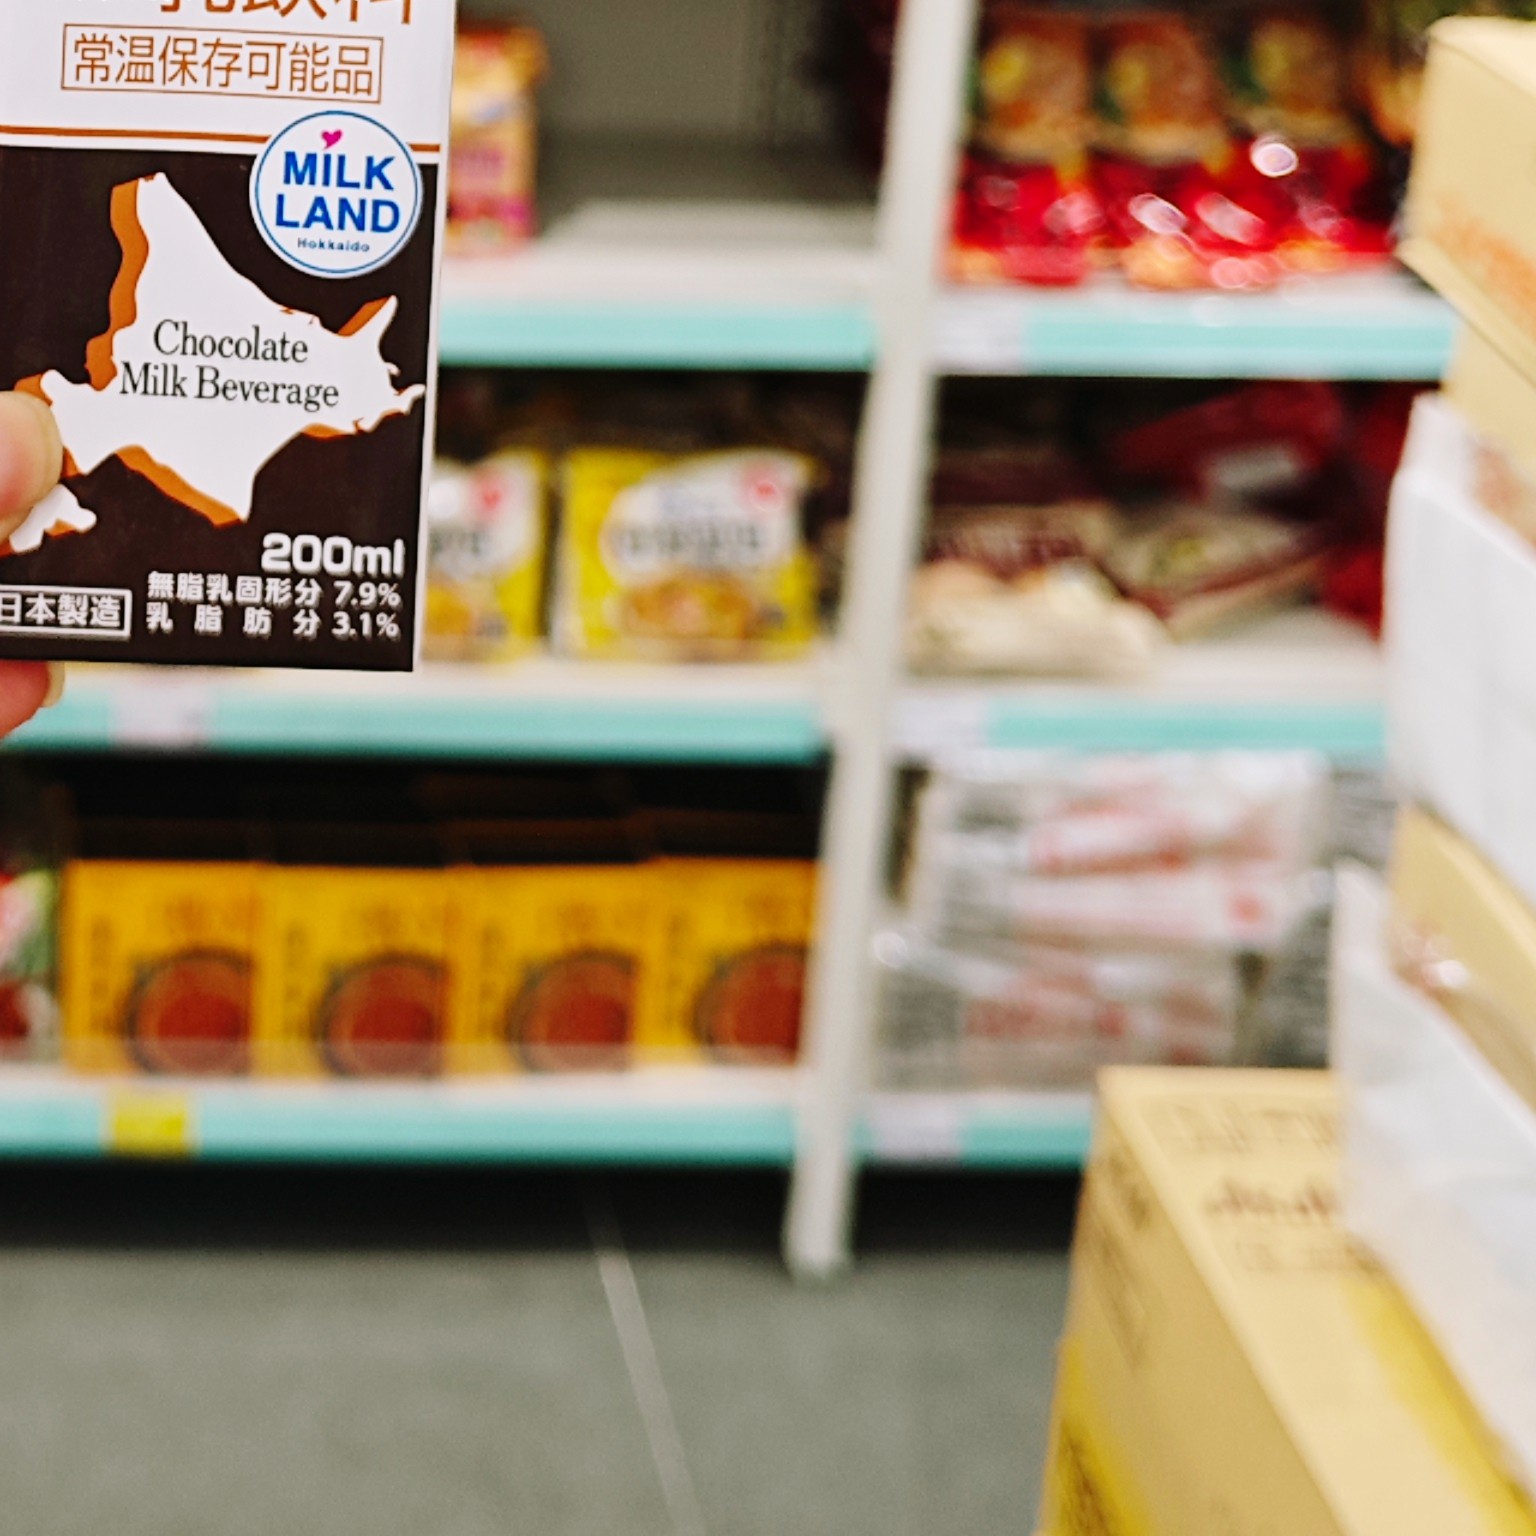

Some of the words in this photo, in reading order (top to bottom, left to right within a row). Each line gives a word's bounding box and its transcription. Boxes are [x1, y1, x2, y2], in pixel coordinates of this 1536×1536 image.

[73, 32, 373, 97] 常温保存可能品
[282, 151, 395, 191] MILK
[275, 193, 401, 233] LAND
[296, 237, 370, 253] Hokkaido
[153, 319, 309, 363] Chocolate
[119, 362, 189, 399] Milk
[194, 365, 341, 412] Beverage
[261, 532, 405, 576] 200ml
[147, 571, 322, 605] 無脂乳固形分
[333, 579, 402, 608] 7.9%
[331, 610, 401, 638] 3.1%
